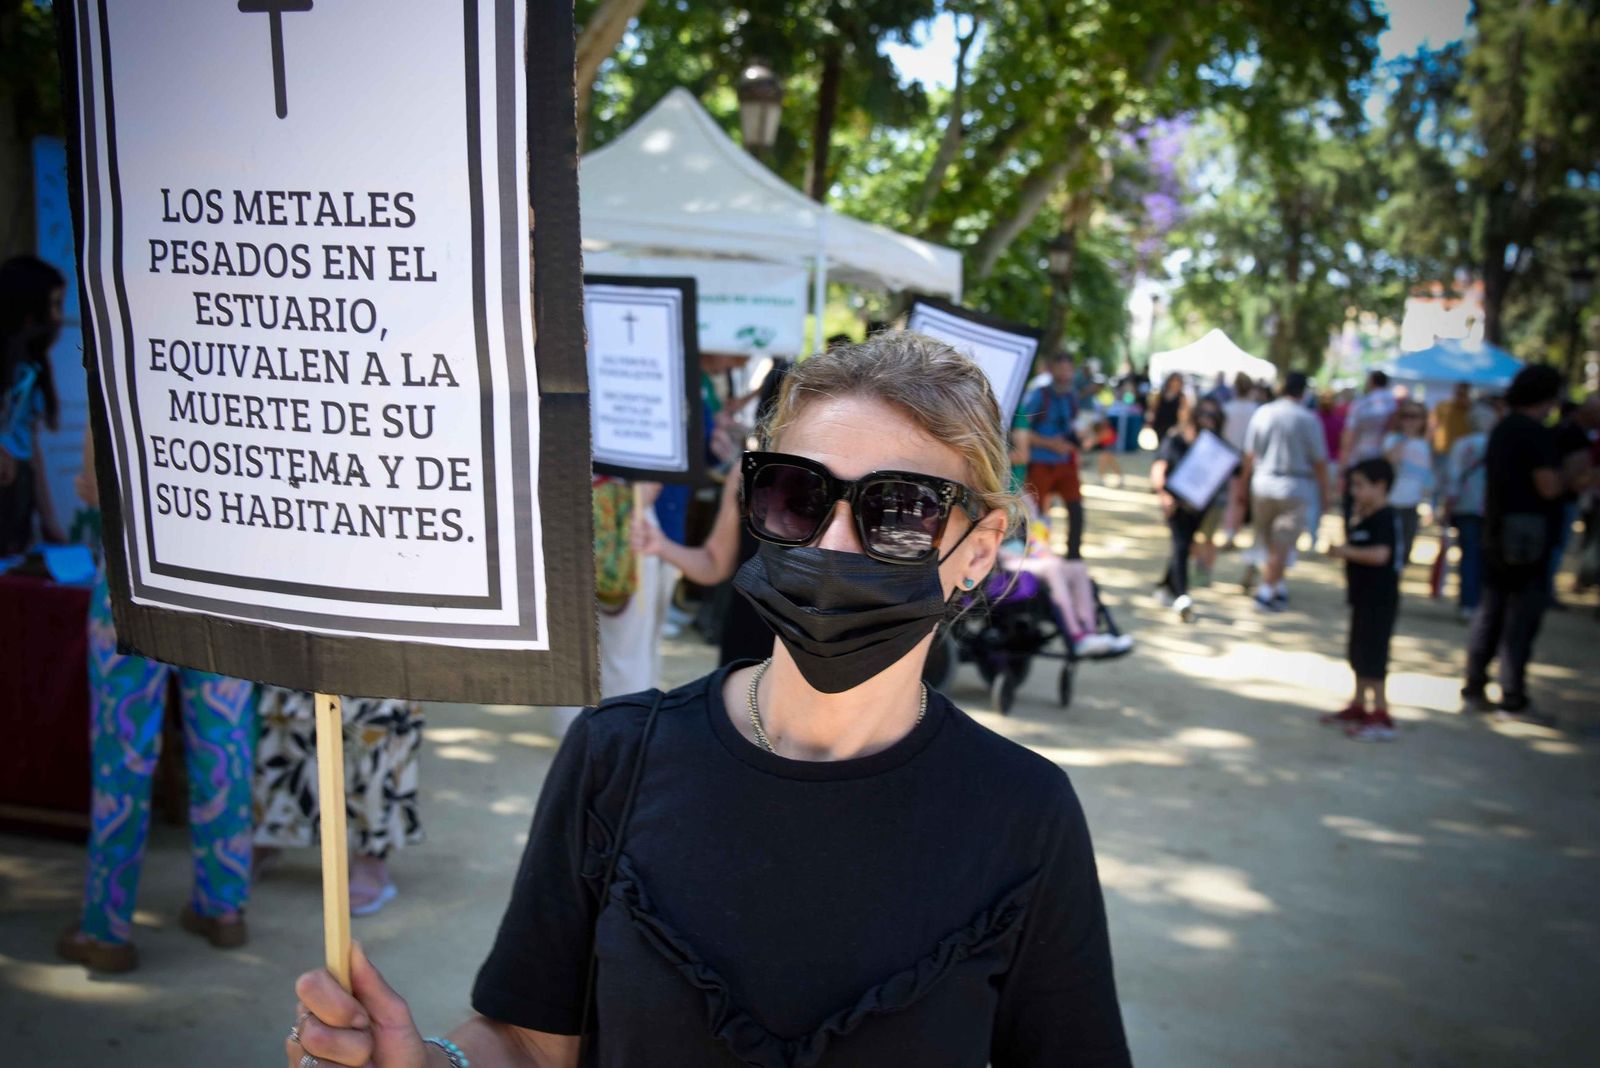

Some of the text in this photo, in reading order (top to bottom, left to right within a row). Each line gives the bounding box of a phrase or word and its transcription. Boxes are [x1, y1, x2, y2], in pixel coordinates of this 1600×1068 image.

[160, 187, 416, 229] LOS METALES
[148, 238, 437, 282] PESADOS EN EL
[192, 291, 388, 342] ESTUARIO,
[148, 337, 460, 387] EQUIVALEN A LA
[168, 388, 436, 440] MUERTE DE SU
[149, 434, 472, 492] ECOSISTEMA Y DE
[156, 482, 474, 543] SUS HABITANTES.
